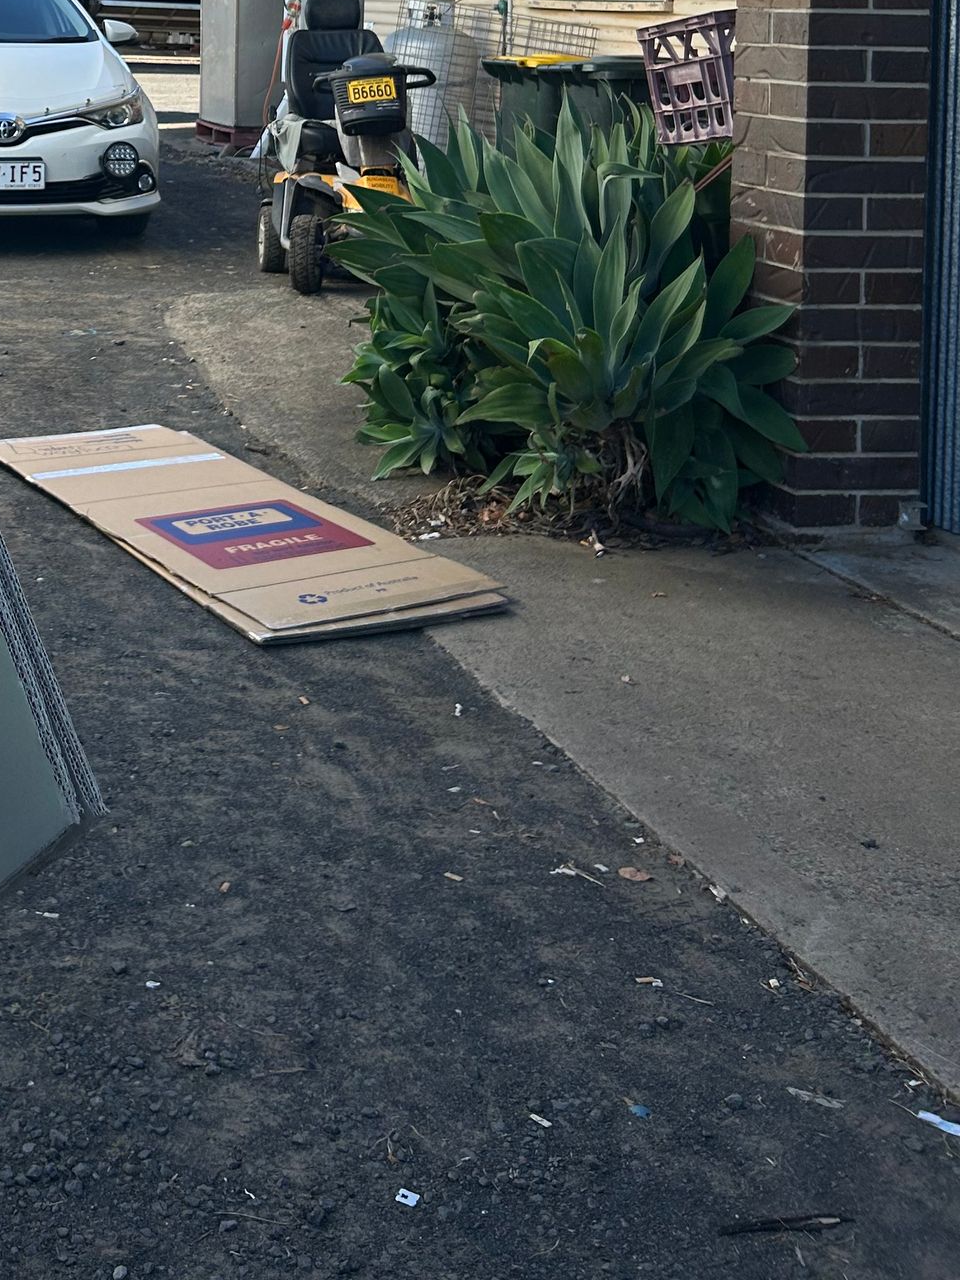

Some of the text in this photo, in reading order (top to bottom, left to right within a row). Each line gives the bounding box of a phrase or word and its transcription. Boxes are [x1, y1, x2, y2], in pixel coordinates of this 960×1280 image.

[352, 84, 392, 100] B6660
[184, 515, 236, 527] PORT
[206, 519, 262, 531] ROBE
[224, 533, 324, 554] FRAGILE
